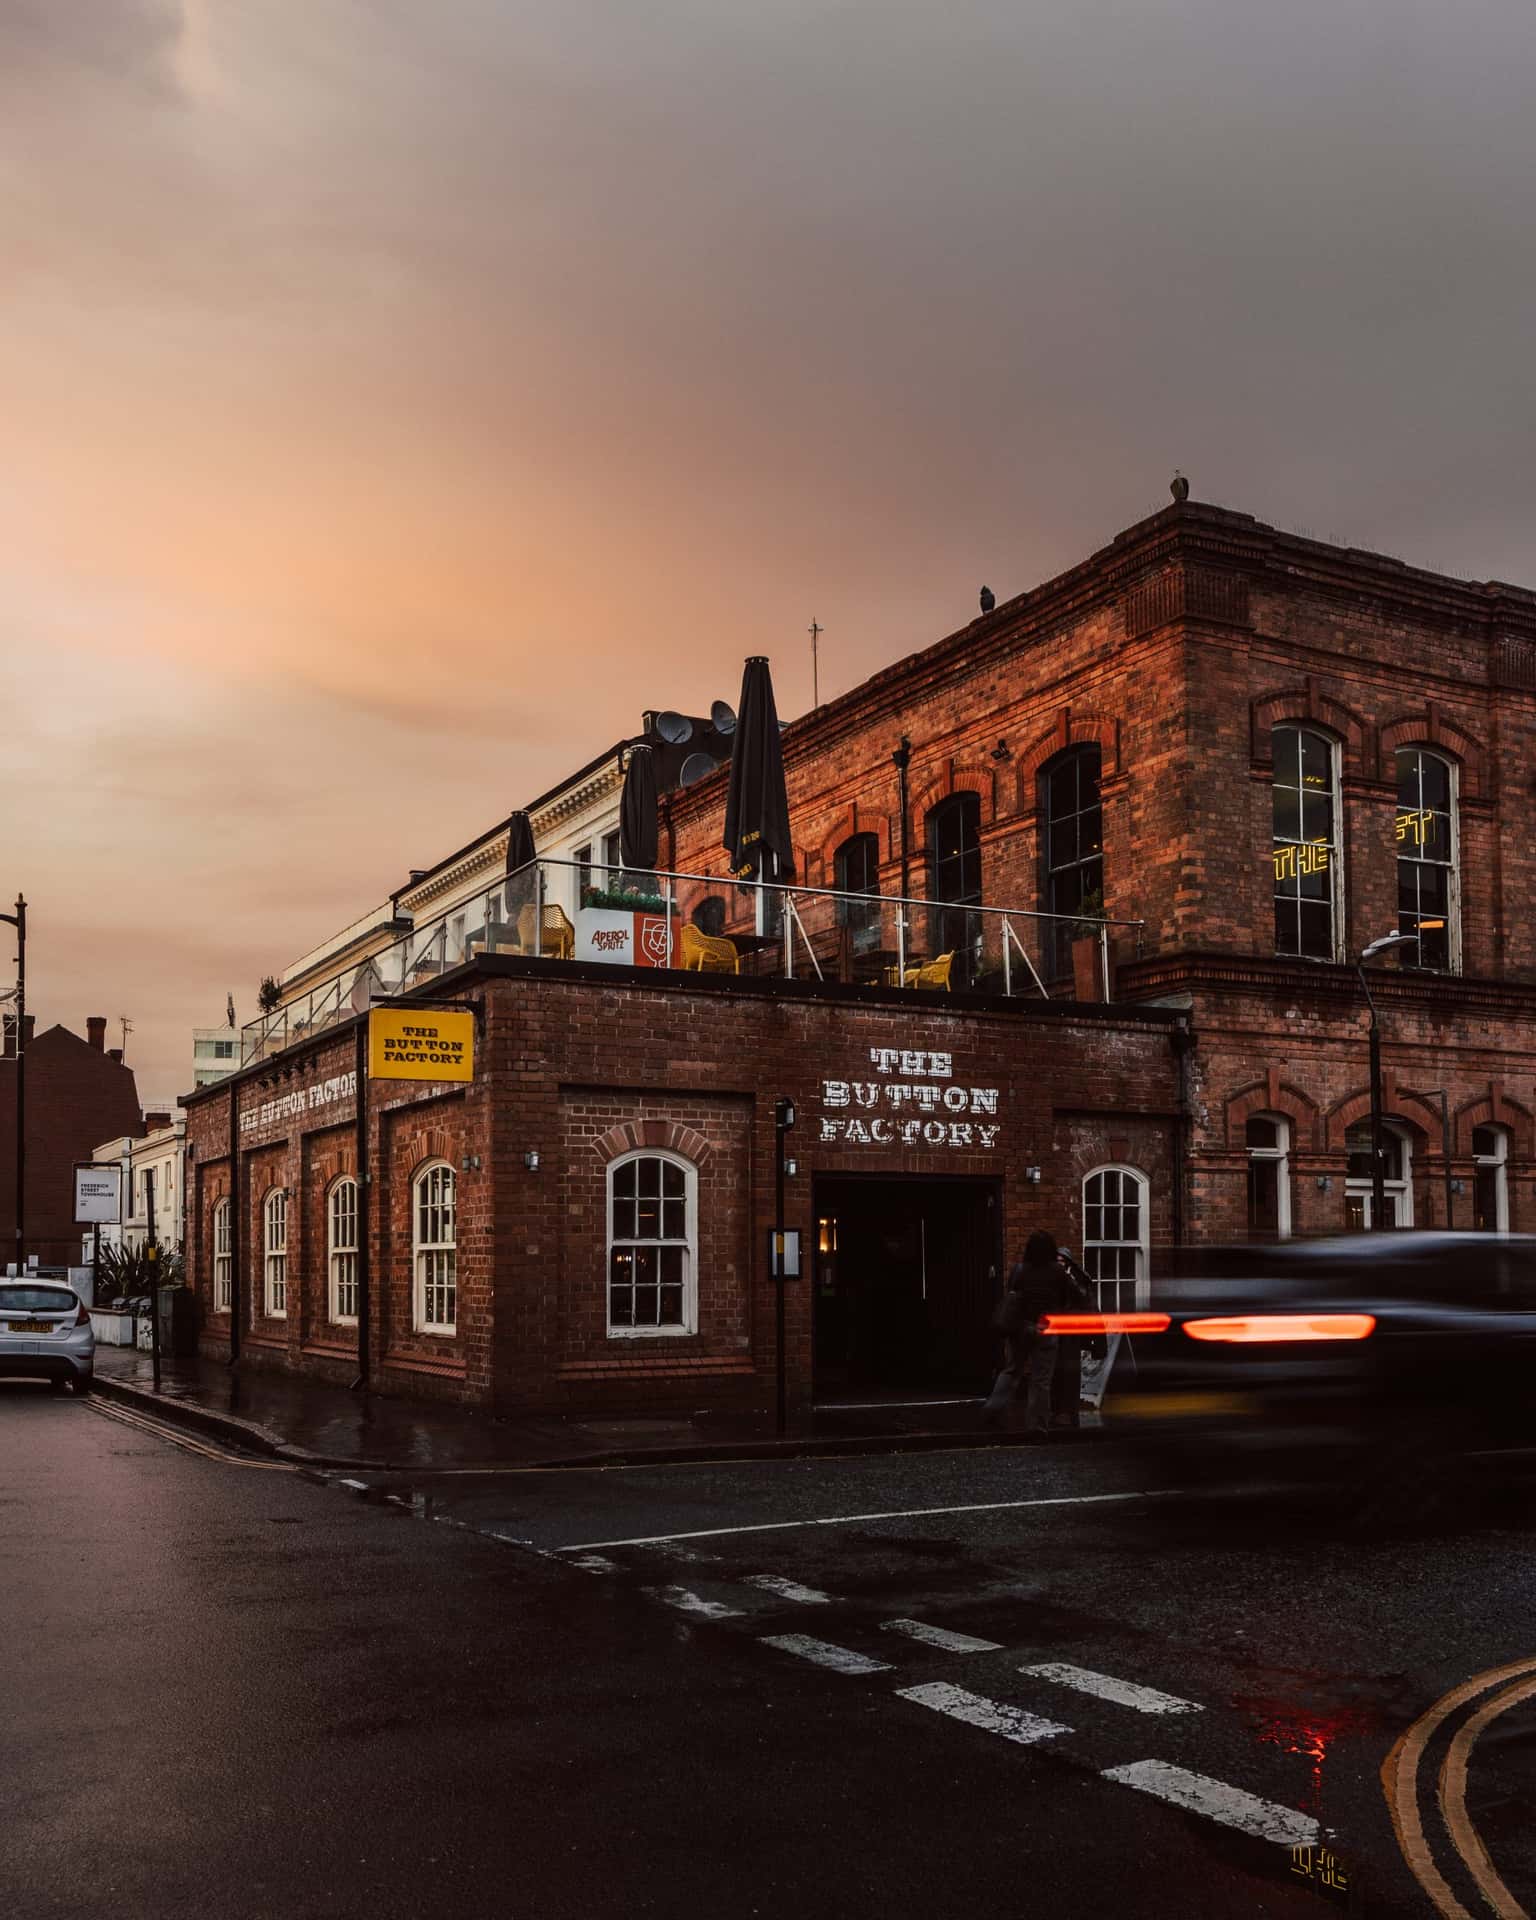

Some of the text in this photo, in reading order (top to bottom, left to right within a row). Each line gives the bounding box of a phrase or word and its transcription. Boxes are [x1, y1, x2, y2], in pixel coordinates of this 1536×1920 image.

[1273, 837, 1328, 881] THE
[591, 929, 630, 944] APEROL
[598, 940, 624, 951] SPRITZ
[402, 1026, 438, 1038] THE
[384, 1038, 464, 1051] BUTTON
[384, 1051, 464, 1064] FACTORY
[870, 1047, 952, 1077] THE
[240, 1066, 368, 1132] THE BUTTON FACTOR
[822, 1080, 999, 1114] BUTTON
[819, 1117, 1001, 1148] FACTORY
